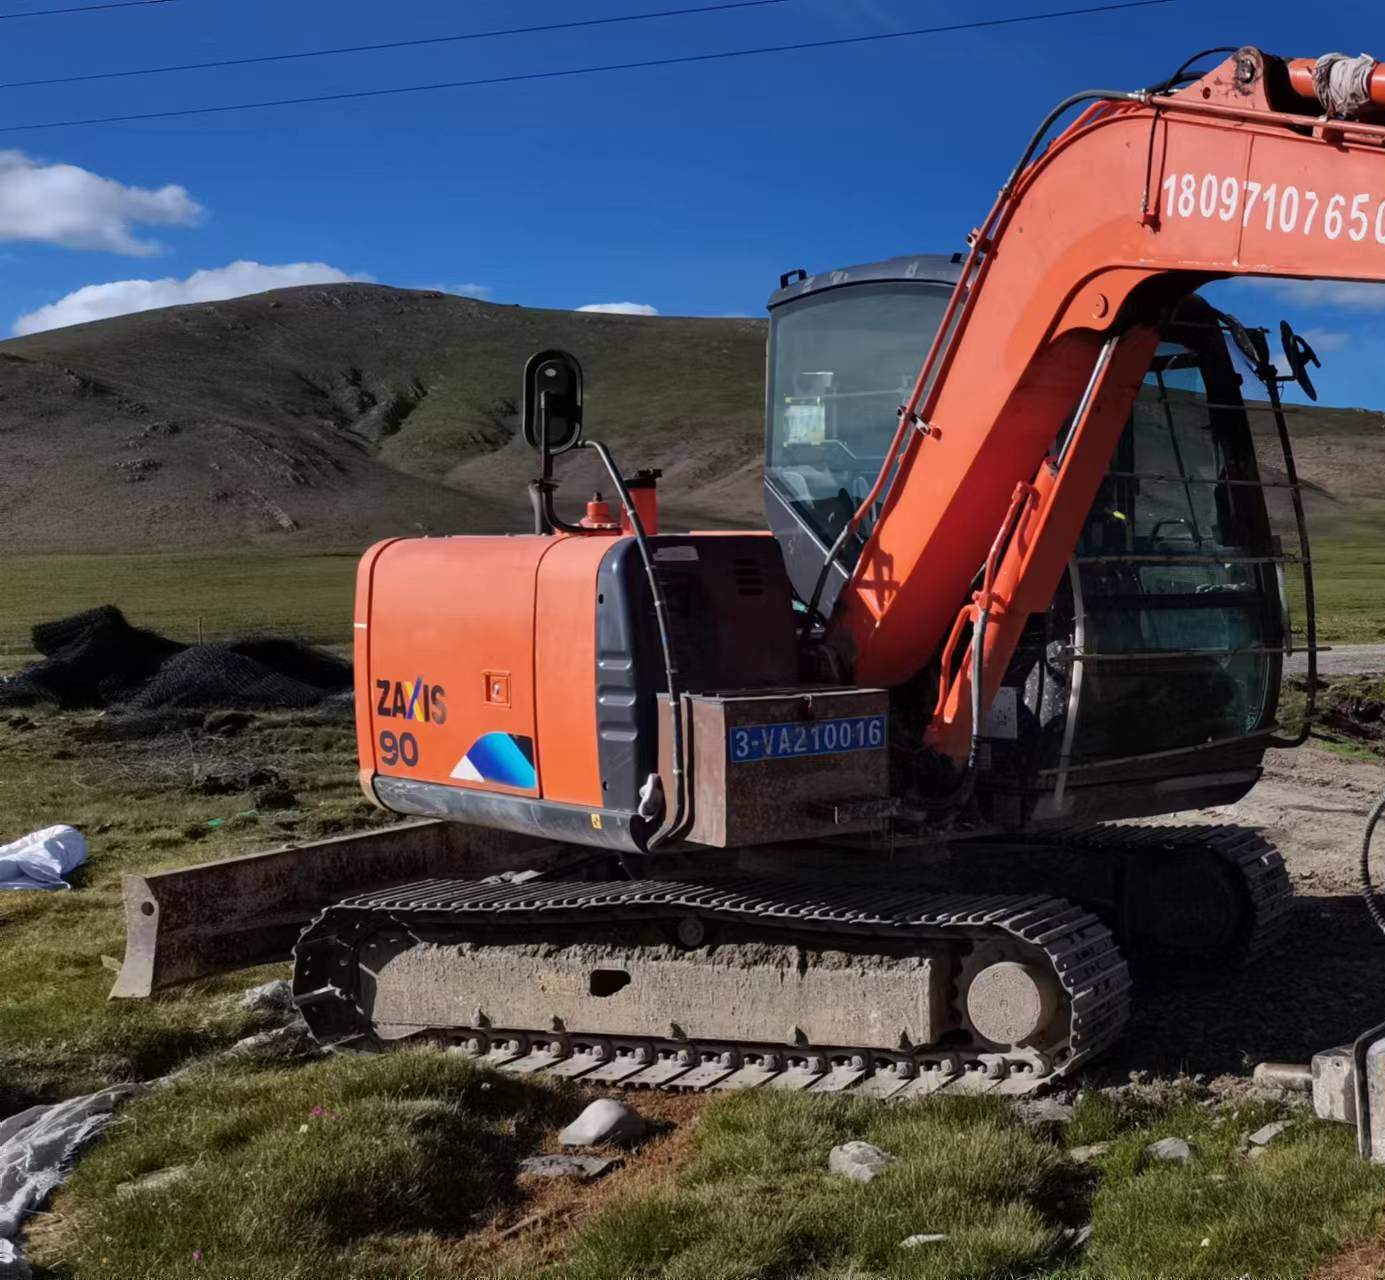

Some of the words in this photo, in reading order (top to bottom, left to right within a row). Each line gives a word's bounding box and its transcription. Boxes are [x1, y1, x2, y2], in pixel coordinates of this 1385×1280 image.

[376, 675, 447, 725] ZAXIS
[379, 729, 419, 768] 90
[735, 719, 881, 757] 3-VA210016
